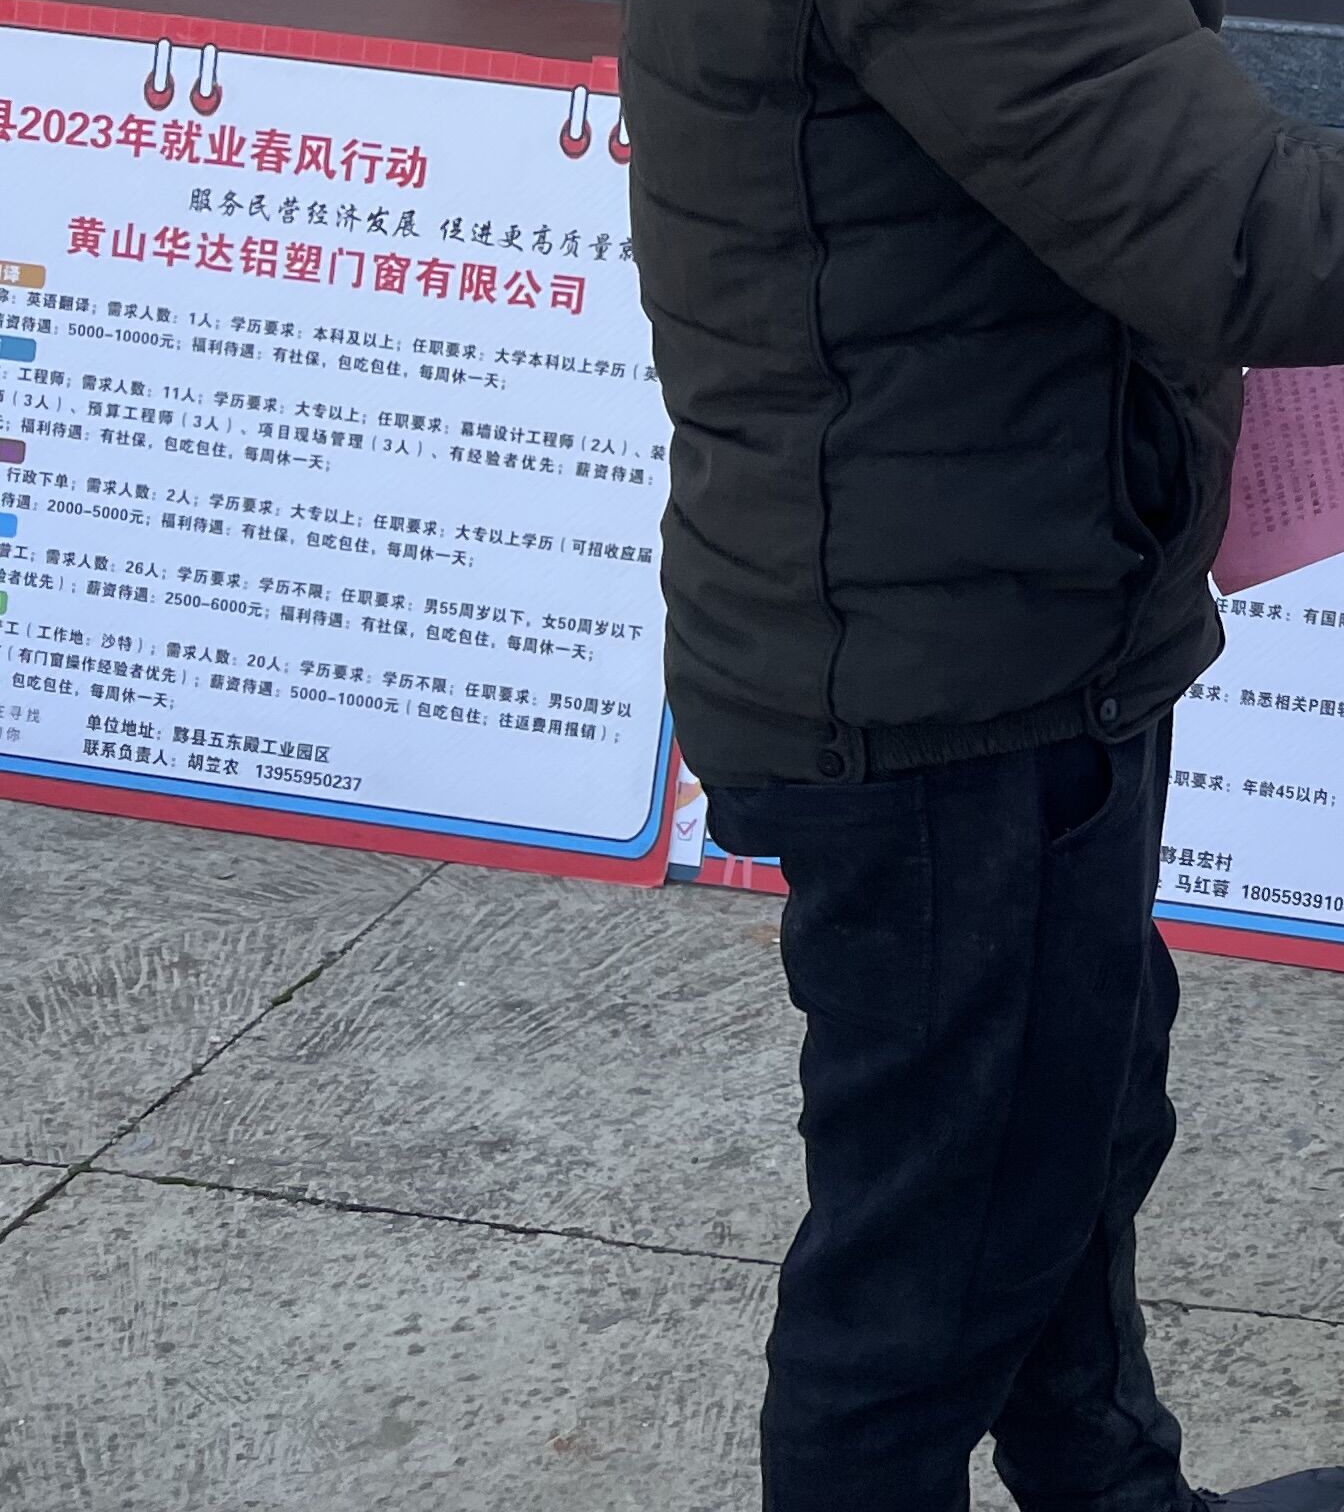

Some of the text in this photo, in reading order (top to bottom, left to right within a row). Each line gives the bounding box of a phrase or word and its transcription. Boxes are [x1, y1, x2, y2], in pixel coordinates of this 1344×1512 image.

[67, 215, 588, 316] 黄山华达铝塑门窗有限公司
